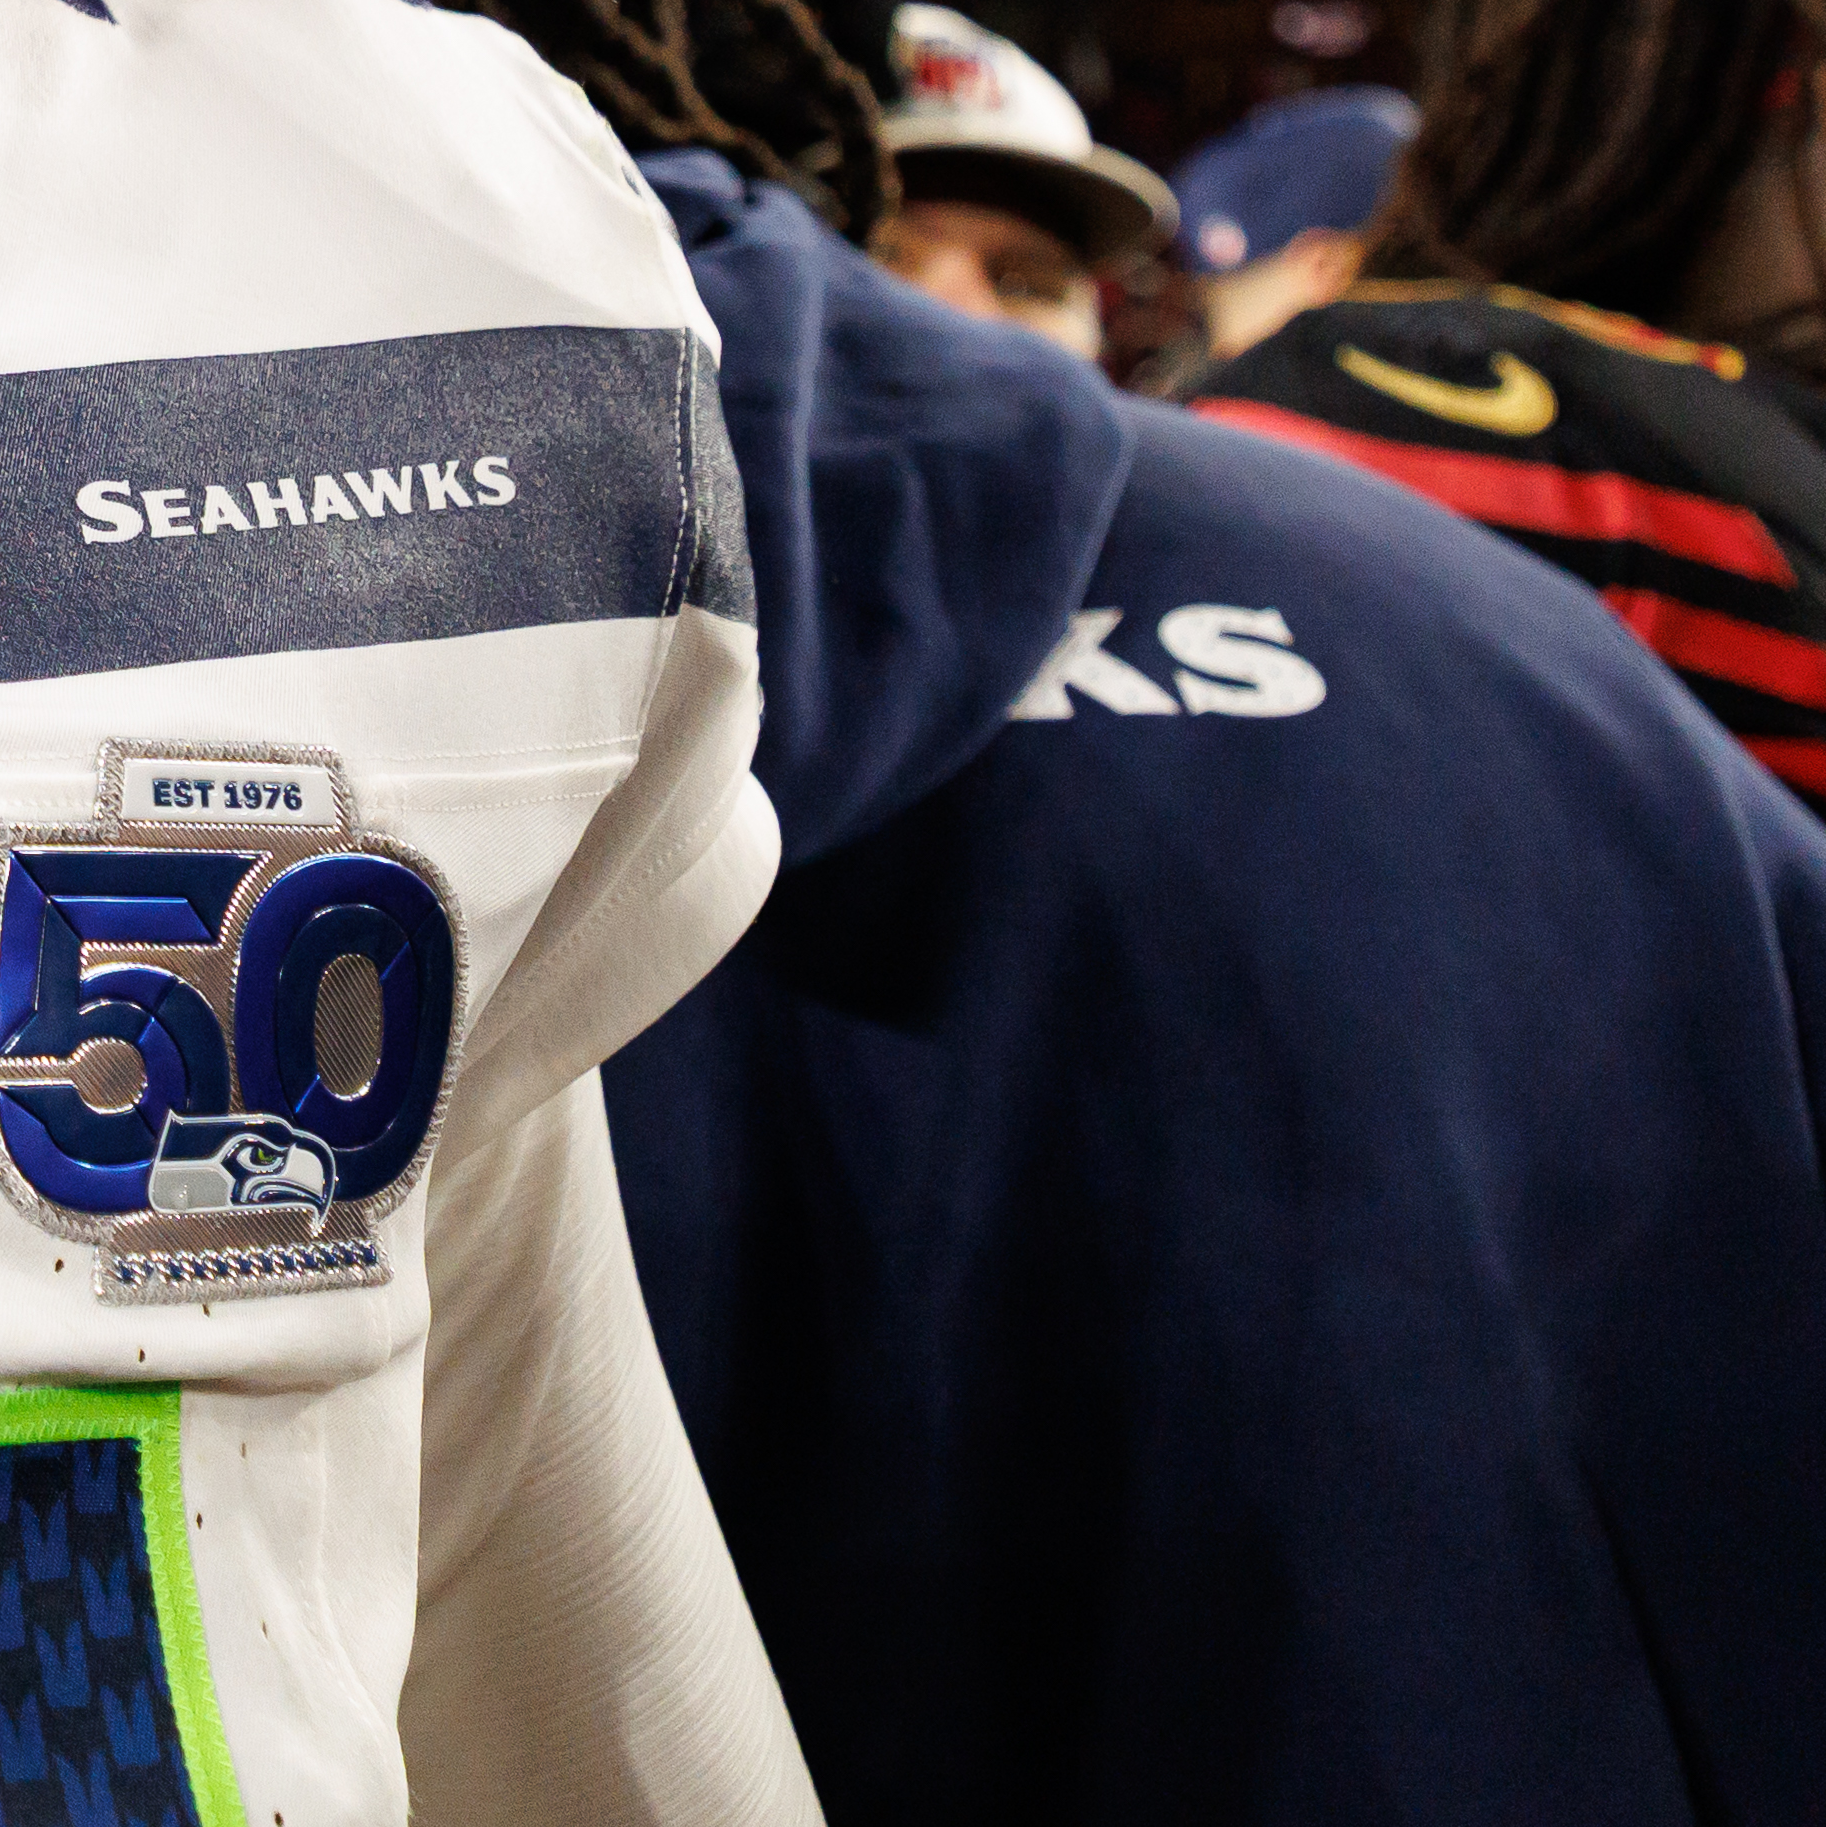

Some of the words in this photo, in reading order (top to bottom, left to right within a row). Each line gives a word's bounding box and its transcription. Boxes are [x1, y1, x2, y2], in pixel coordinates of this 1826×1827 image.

[75, 456, 517, 544] SEAHAWKS
[152, 778, 215, 808] EST
[223, 780, 303, 811] 1976
